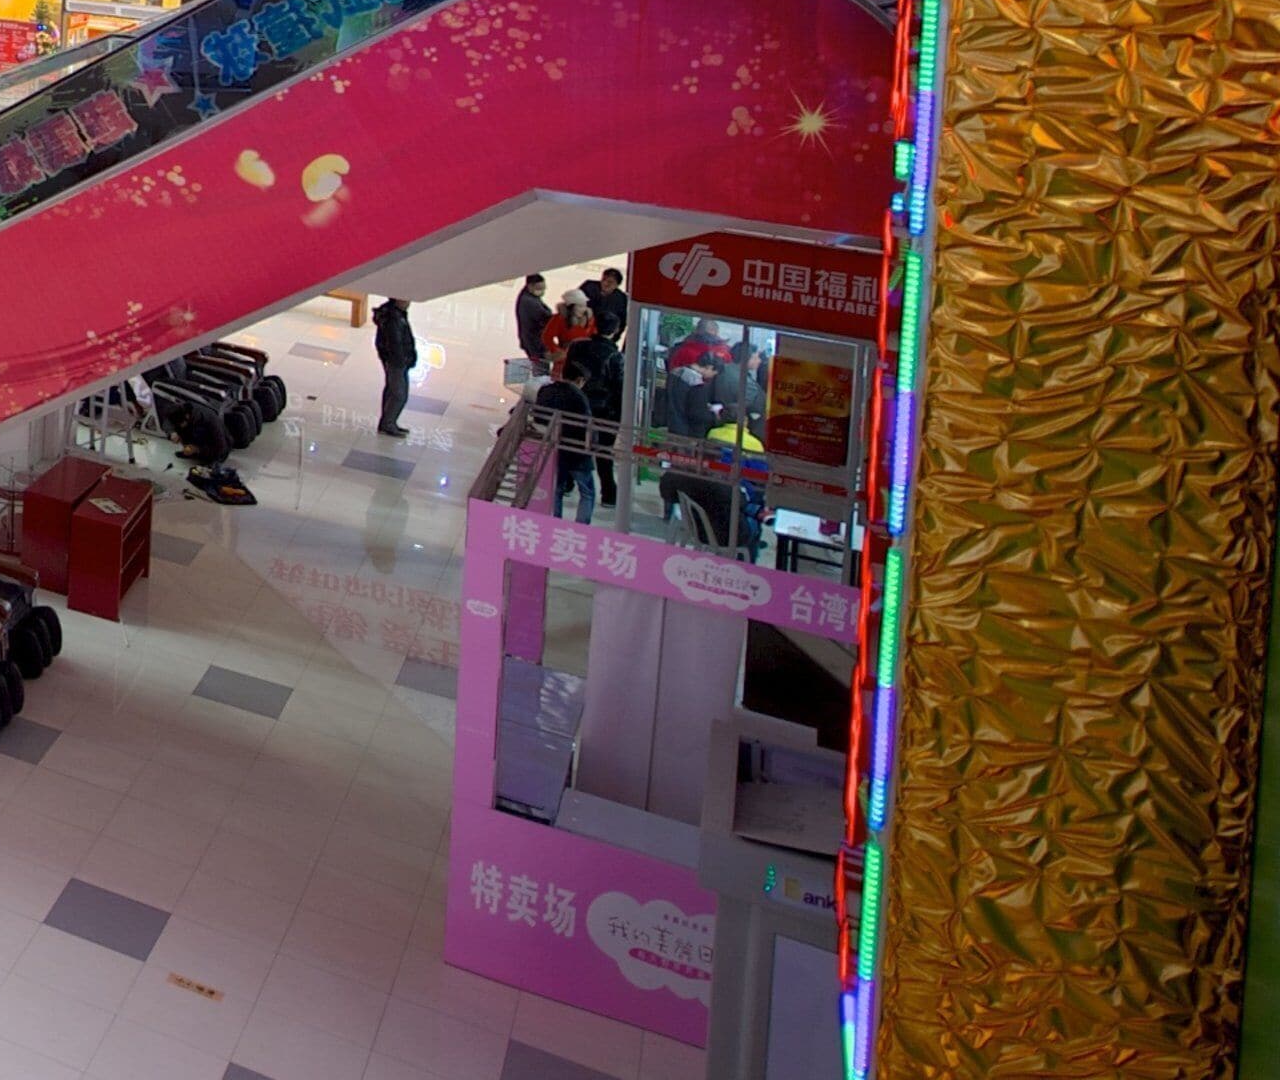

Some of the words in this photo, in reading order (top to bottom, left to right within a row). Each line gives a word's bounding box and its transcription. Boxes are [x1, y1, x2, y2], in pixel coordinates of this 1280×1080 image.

[741, 284, 794, 304] CHINA
[800, 294, 877, 317] WELFARE
[742, 258, 880, 305] 中国福利
[501, 514, 638, 580] 特卖场
[469, 859, 577, 938] 特卖场
